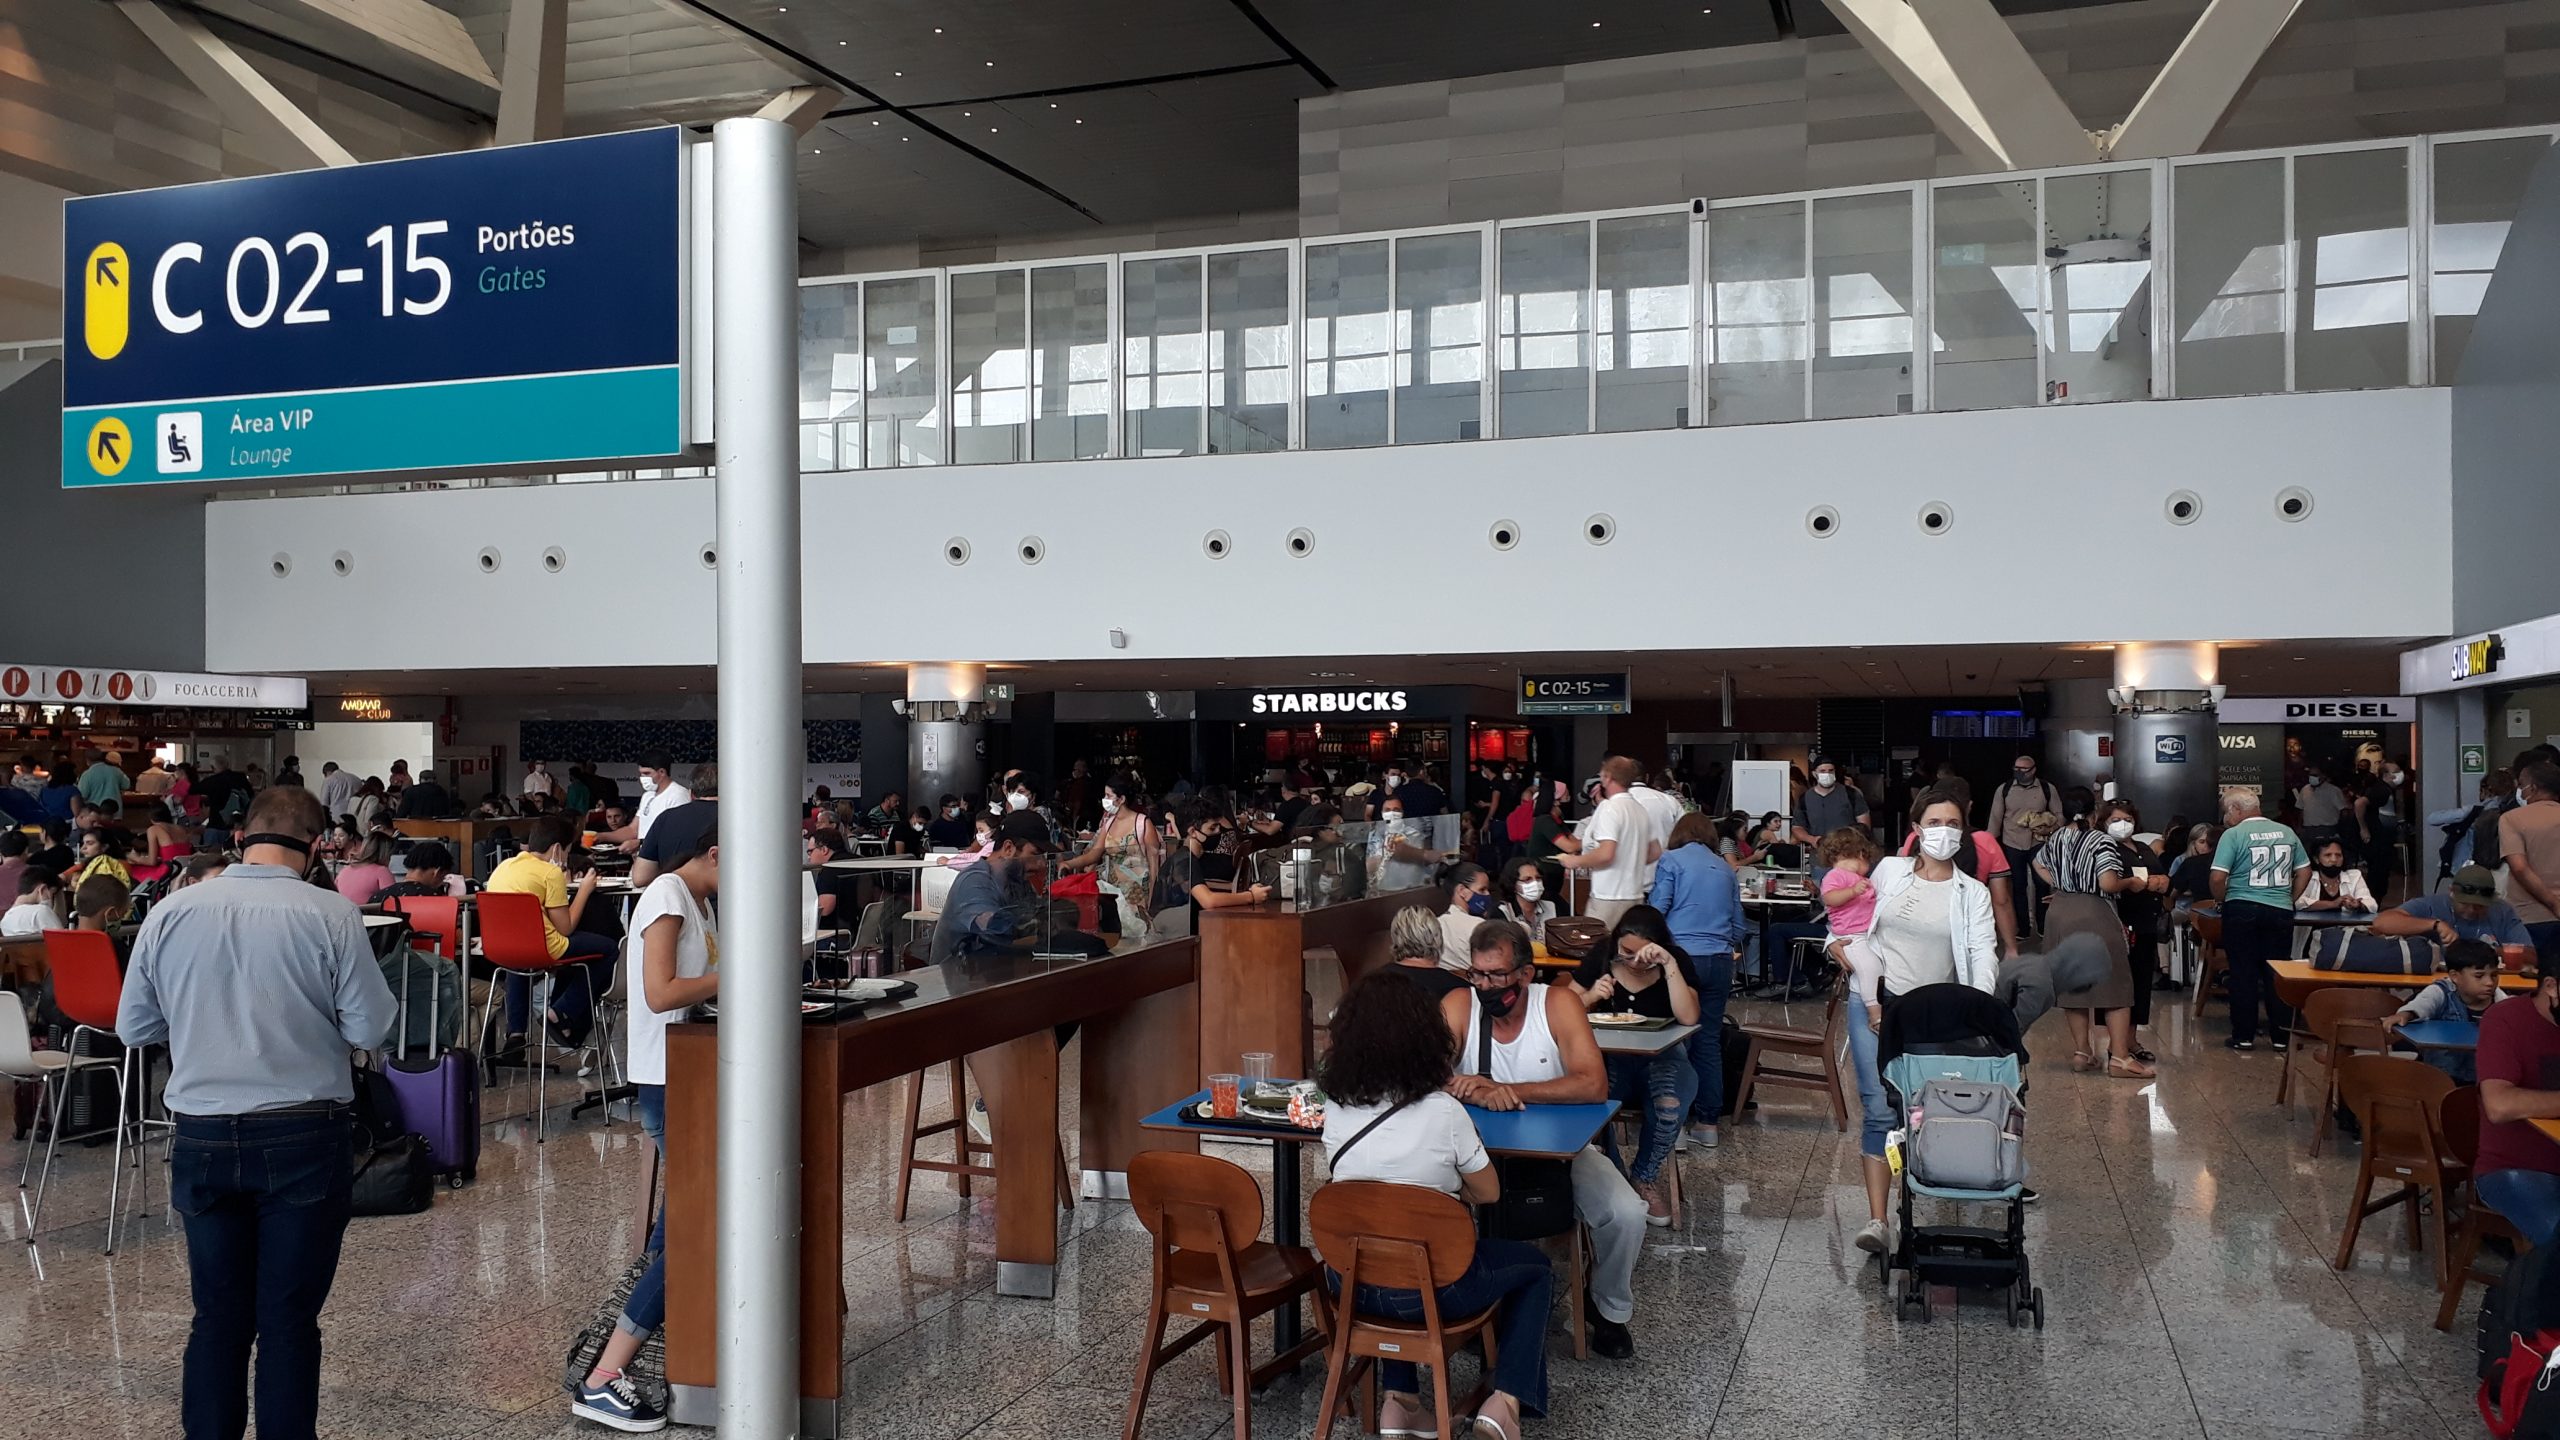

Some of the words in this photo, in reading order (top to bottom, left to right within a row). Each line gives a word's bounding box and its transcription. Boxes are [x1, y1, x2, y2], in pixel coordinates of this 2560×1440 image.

[478, 221, 576, 255] Portões
[152, 241, 203, 334] C
[226, 219, 452, 330] 02-15
[479, 265, 547, 294] Gates
[230, 408, 275, 435] Área
[279, 408, 314, 431] VIP
[230, 446, 293, 469] Lounge
[2451, 639, 2492, 680] SUBWAY
[11, 669, 150, 699] PIAZZA
[174, 683, 259, 698] FOCACCERIA
[1539, 681, 1550, 695] C
[1552, 681, 1591, 695] 02-15
[1252, 691, 1408, 713] STARBUCKS
[2286, 703, 2398, 717] DIESEL
[2218, 735, 2257, 749] VISA
[2248, 844, 2292, 887] 22
